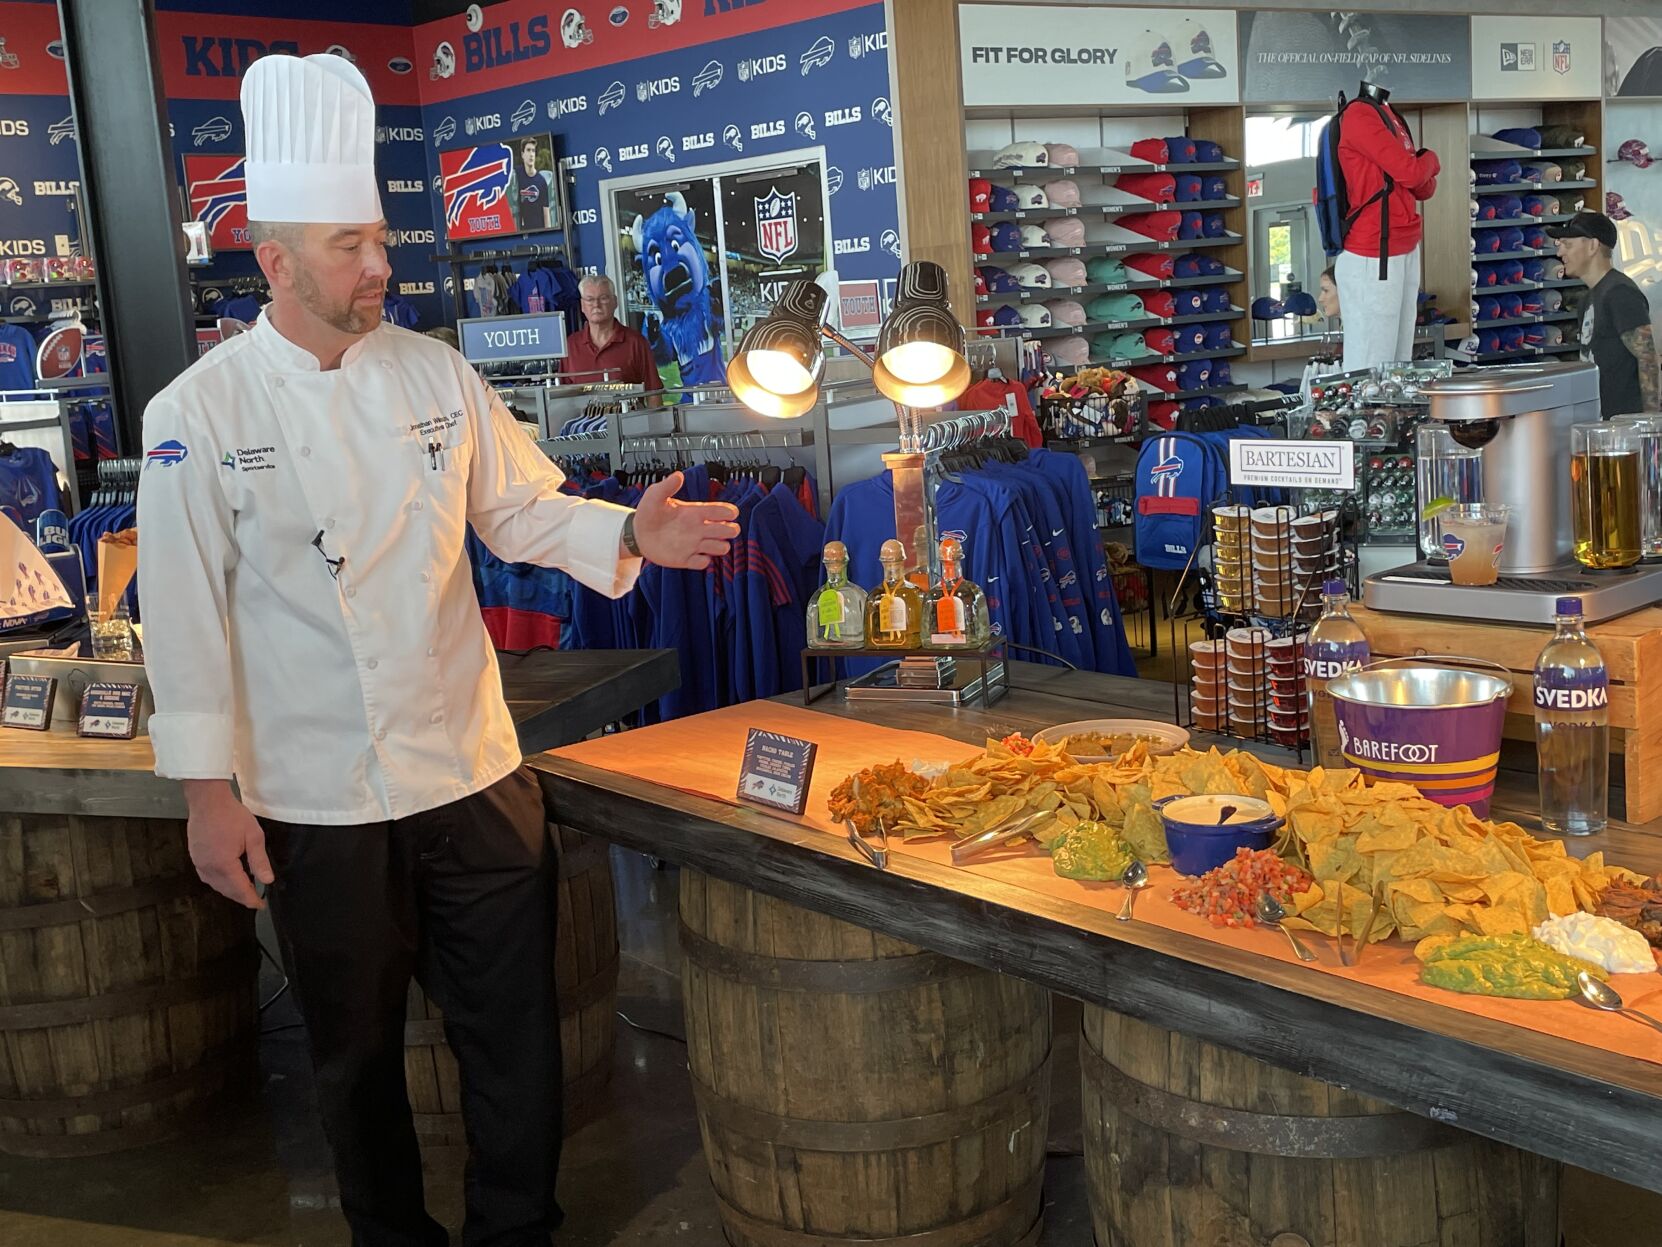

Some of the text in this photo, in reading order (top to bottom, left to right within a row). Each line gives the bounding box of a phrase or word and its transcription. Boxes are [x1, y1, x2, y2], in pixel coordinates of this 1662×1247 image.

[462, 15, 551, 73] BILLS
[972, 47, 1118, 64] FIT FOR GLORY
[1257, 53, 1452, 64] THE OFFICIAL ON-FIELD CAP OF NFL SIDELINES
[1554, 55, 1569, 70] NFL
[752, 54, 787, 76] KIDS
[650, 76, 680, 95] KIDS
[560, 95, 587, 115] KIDS
[475, 113, 501, 131] KIDS
[825, 106, 862, 127] BILLS
[0, 120, 29, 136] DS
[389, 128, 424, 141] KIDS
[751, 120, 786, 139] BILLS
[682, 132, 715, 151] BILLS
[618, 144, 649, 161] BILLS
[560, 154, 588, 170] ILLS
[34, 181, 80, 196] BILLS
[388, 180, 424, 193] BILLS
[468, 215, 501, 232] YOUTH
[401, 230, 435, 245] KIDS
[762, 220, 793, 253] NFL
[0, 239, 46, 256] KIDS
[834, 236, 871, 255] BILLS
[399, 281, 435, 294] BILLS
[842, 296, 876, 316] YOUTH
[484, 328, 540, 348] YOUTH
[237, 446, 275, 456] Delaware
[1246, 450, 1336, 468] BARTESIAN
[239, 455, 265, 465] North
[1271, 475, 1302, 483] COCKTAILS
[1165, 544, 1187, 554] BILLS
[1536, 687, 1608, 708] SVEDKA
[1354, 737, 1438, 763] BAREFOOT
